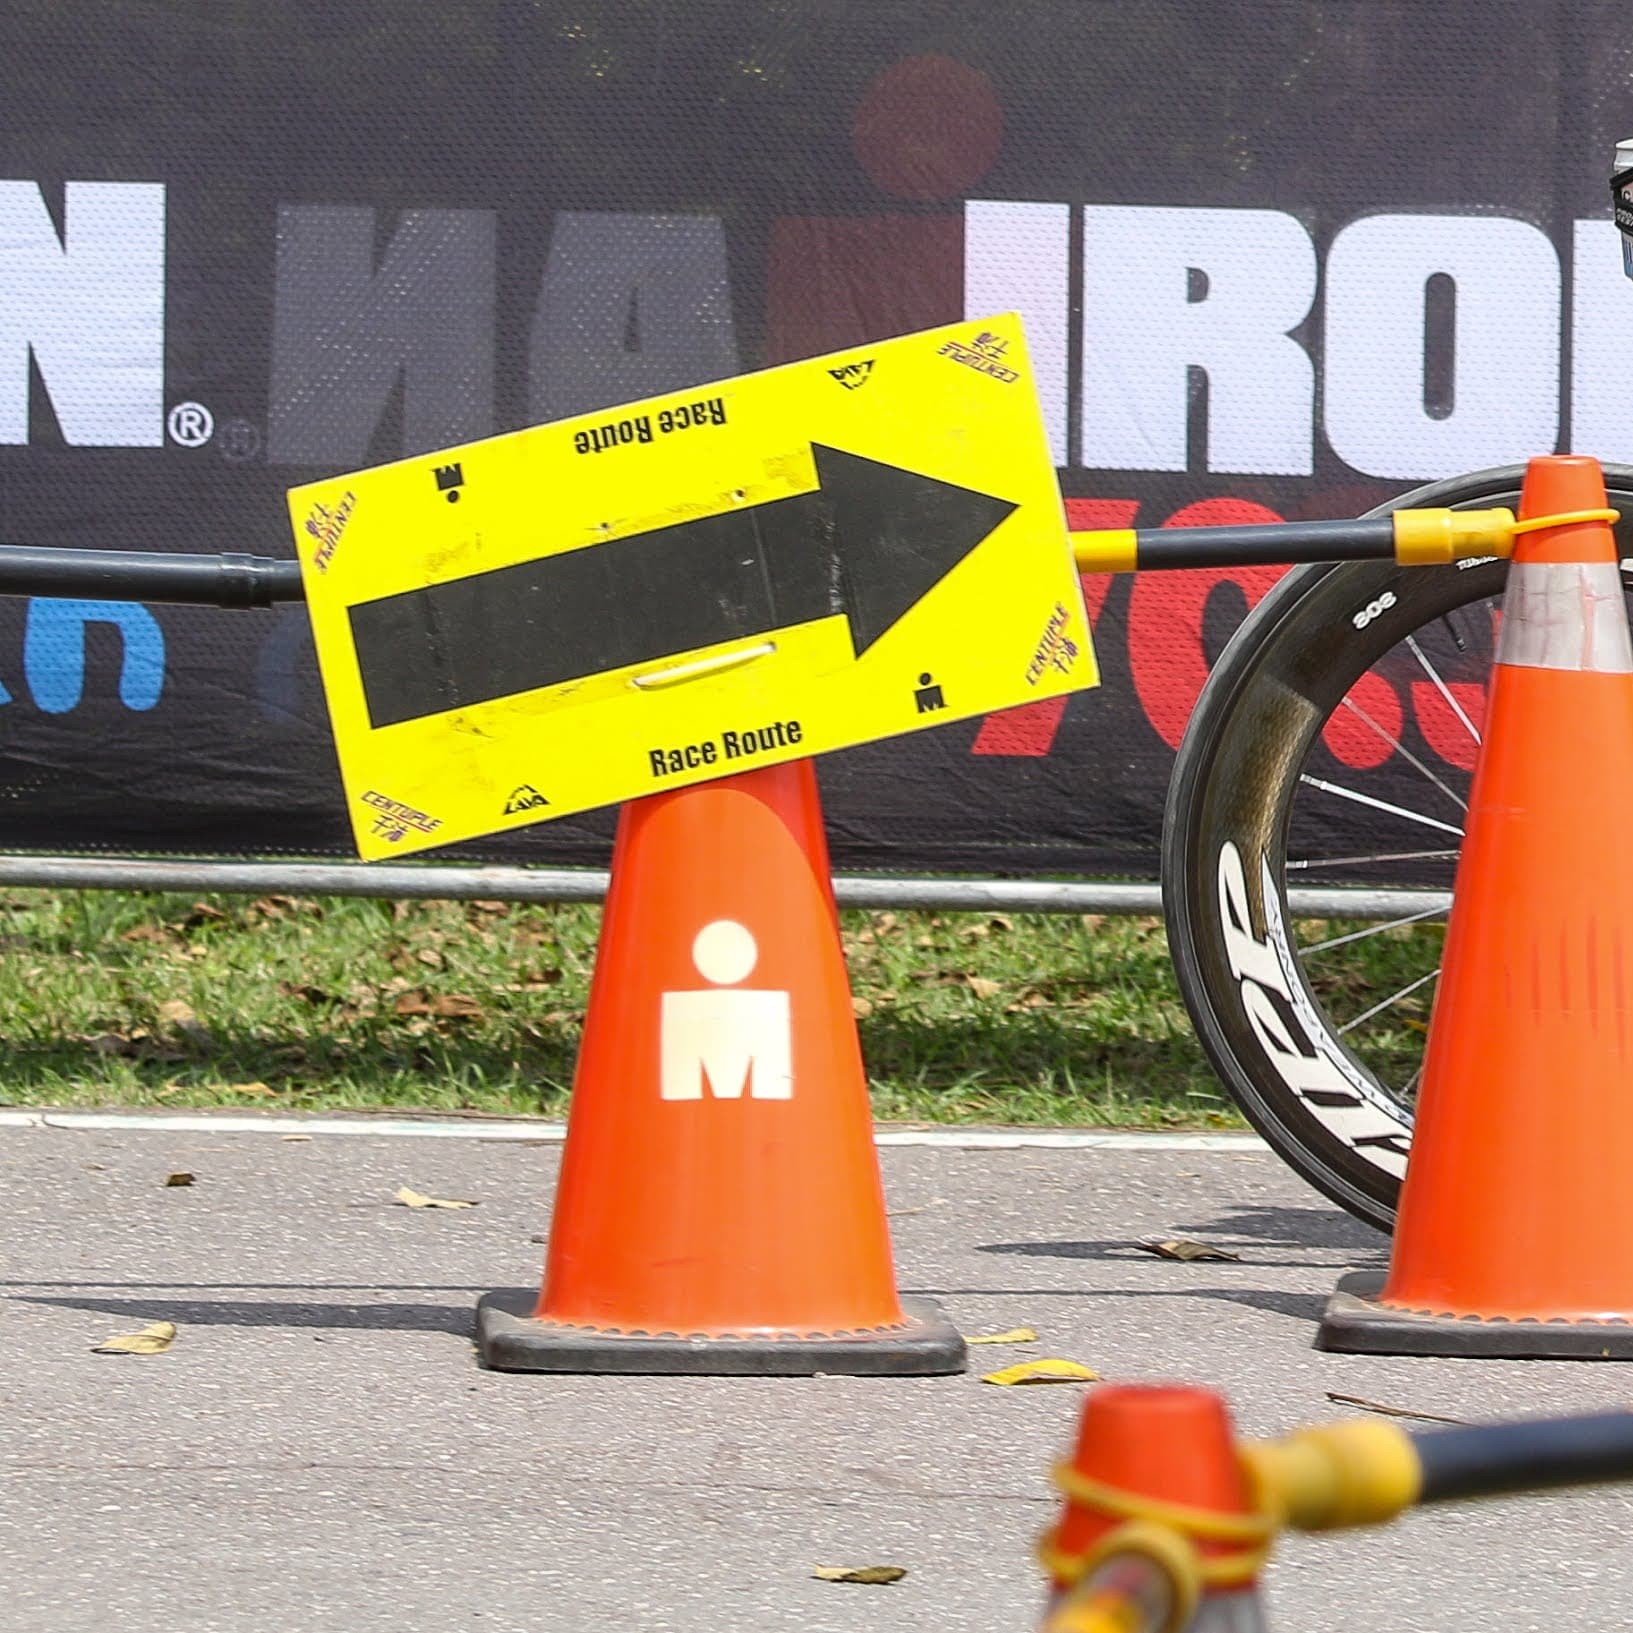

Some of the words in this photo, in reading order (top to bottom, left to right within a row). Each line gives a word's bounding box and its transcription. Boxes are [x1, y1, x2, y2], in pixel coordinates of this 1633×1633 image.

[573, 416, 655, 455] Route
[658, 398, 727, 435] Race
[648, 735, 718, 778] Race
[720, 720, 804, 762] Route
[360, 790, 446, 832] CENTUPLE
